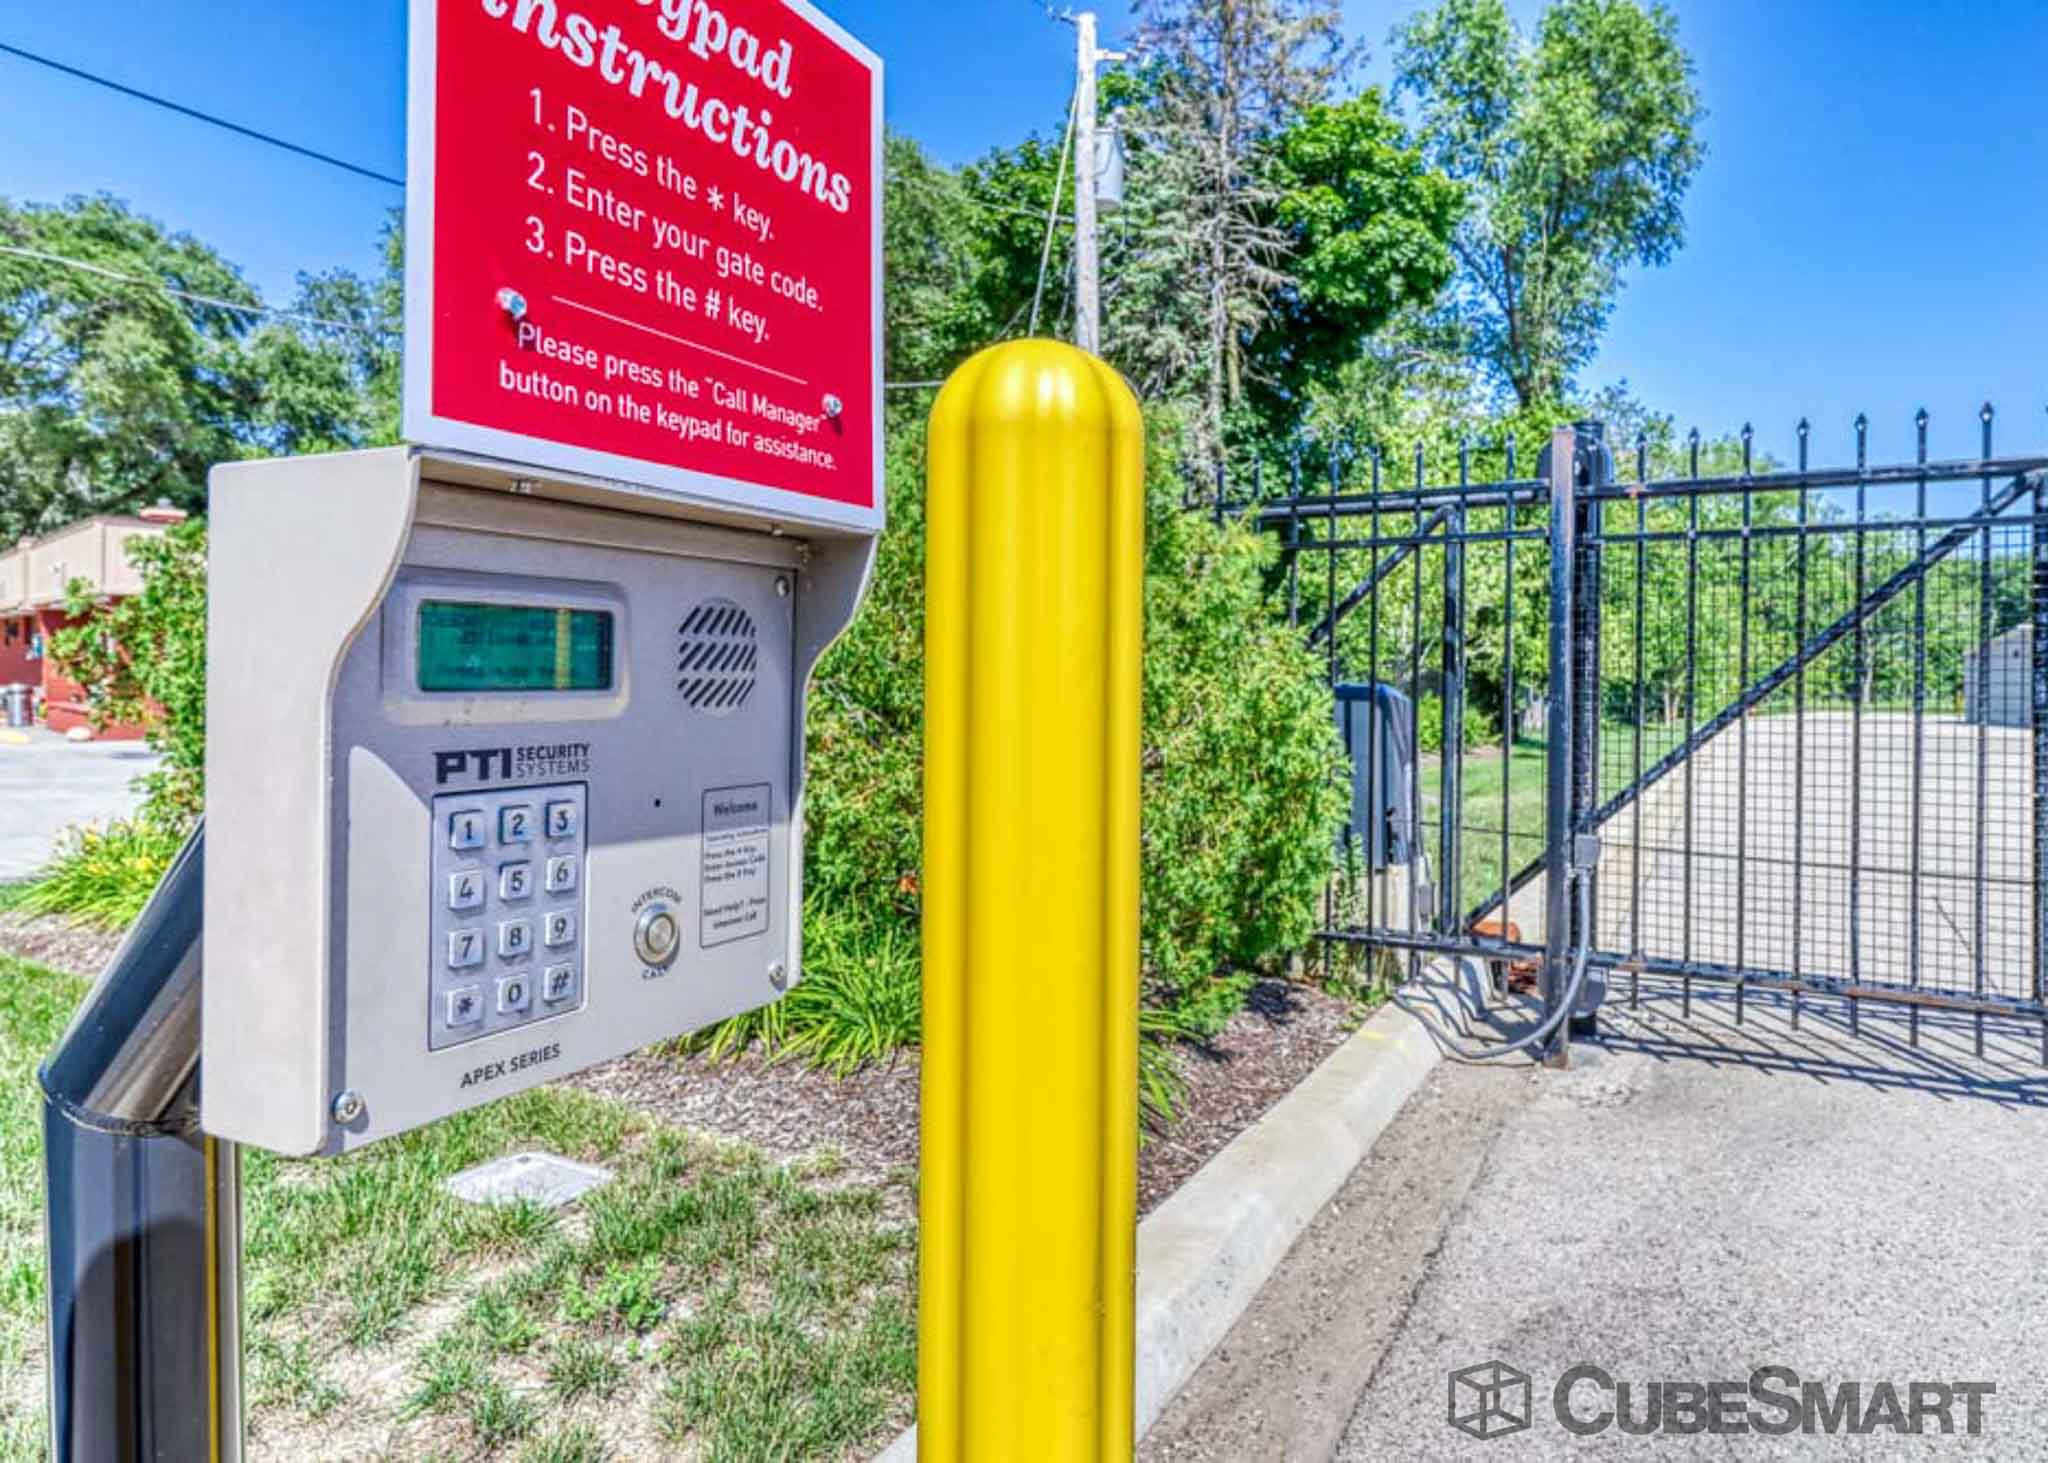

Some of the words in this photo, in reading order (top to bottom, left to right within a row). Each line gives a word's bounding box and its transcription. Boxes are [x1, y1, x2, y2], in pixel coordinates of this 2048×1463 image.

[635, 0, 793, 98] ypad
[482, 0, 852, 213] nstructions
[530, 88, 555, 132] 1.
[567, 104, 649, 177] Press
[656, 155, 697, 200] the
[733, 192, 775, 242] key.
[527, 151, 554, 195] 2.
[566, 168, 646, 232] Enter
[653, 216, 710, 259] your
[716, 247, 764, 285] gate
[771, 271, 823, 312] code.
[525, 216, 554, 259] 3.
[565, 230, 648, 292] Press
[656, 270, 697, 311] the
[705, 288, 721, 320] #
[728, 296, 770, 343] key.
[518, 321, 598, 369] Please
[604, 354, 663, 388] press
[668, 369, 699, 398] the
[499, 359, 578, 405] button
[585, 390, 612, 414] on
[618, 394, 650, 423] the
[657, 402, 721, 442] keypad
[726, 421, 750, 448] for
[753, 434, 837, 471] assistance.
[433, 748, 511, 784] PTI
[516, 743, 590, 761] SECURITY
[516, 760, 590, 778] SYSTEMS
[512, 813, 524, 836] 2
[556, 810, 567, 831] 3
[460, 877, 473, 899] 4
[512, 870, 523, 892] 5
[556, 862, 568, 883] 6
[462, 936, 473, 959] 7
[510, 927, 521, 947] 8
[555, 918, 566, 938] 9
[552, 971, 568, 993] #
[460, 1059, 505, 1088] APEX
[510, 1043, 560, 1072] SERIES
